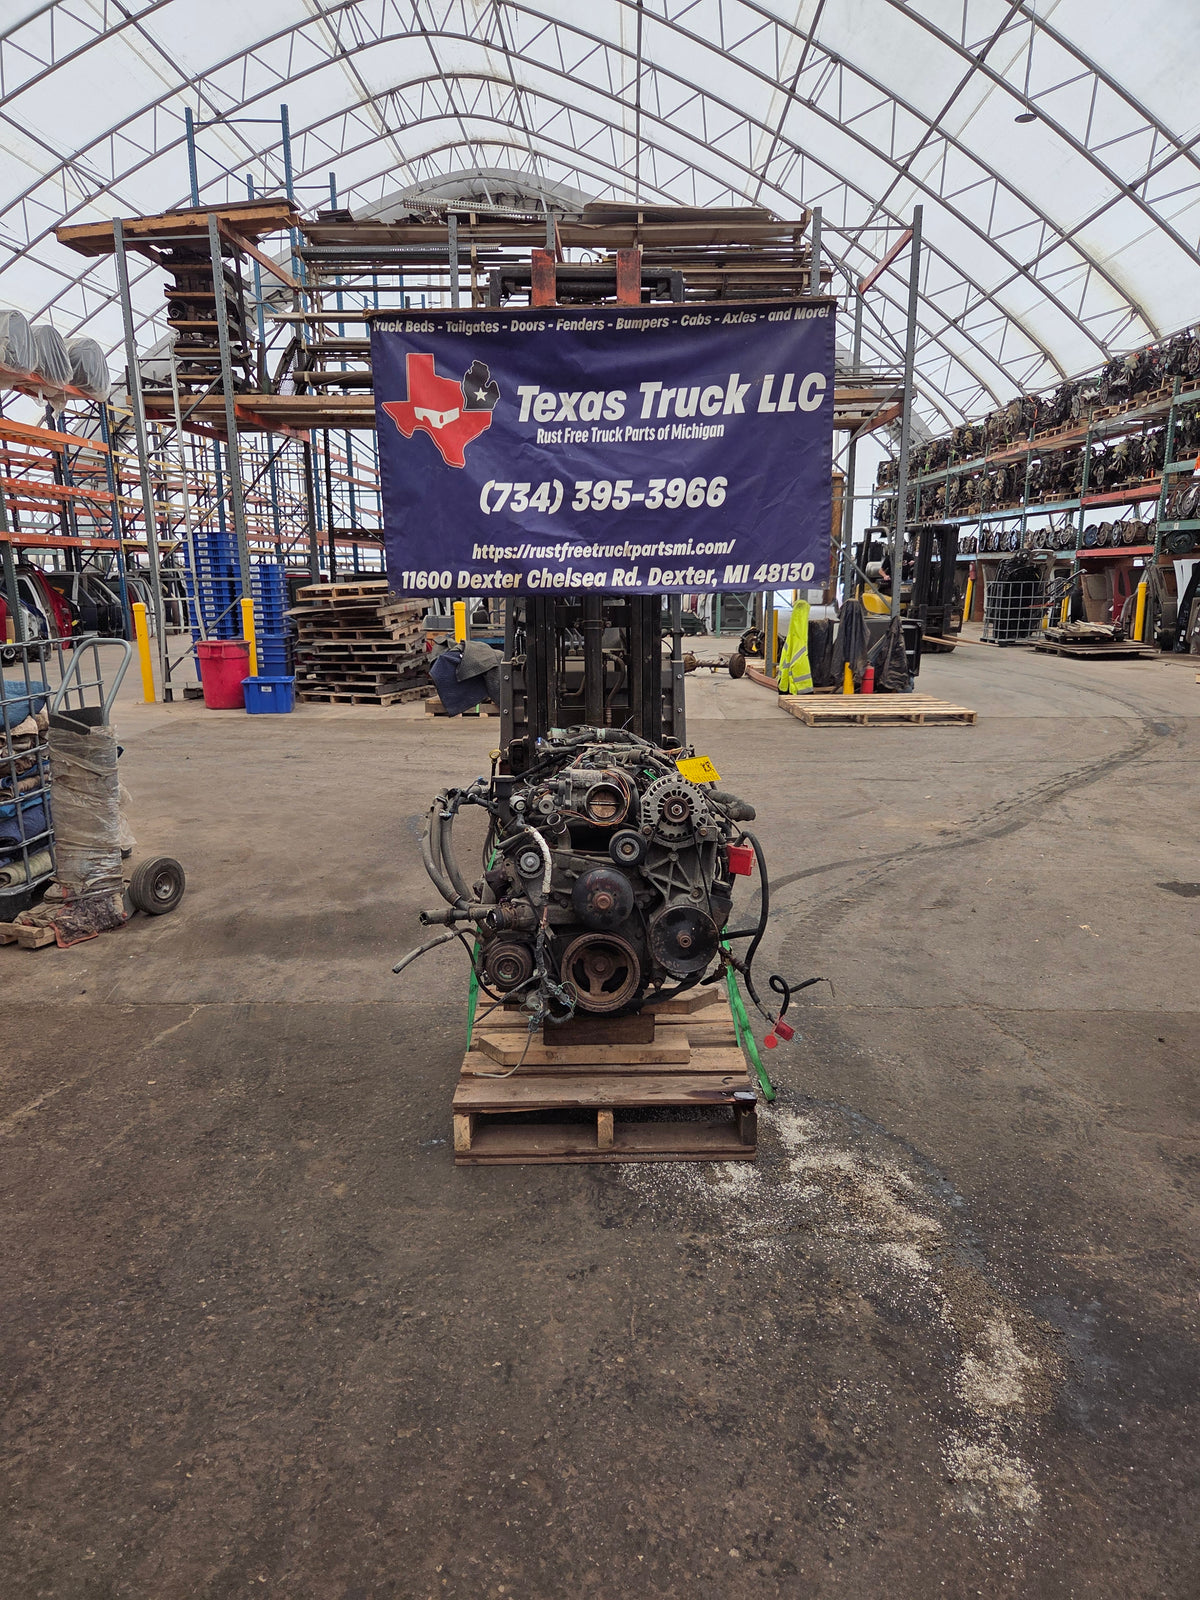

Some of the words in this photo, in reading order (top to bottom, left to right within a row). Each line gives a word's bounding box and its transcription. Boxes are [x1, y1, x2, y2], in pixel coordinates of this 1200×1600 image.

[405, 320, 435, 332] Beds
[446, 319, 500, 336] Tailgates
[510, 319, 546, 332] Doors
[556, 318, 605, 331] Fenders
[616, 316, 669, 332] Bumpers
[680, 314, 711, 327] Cabs
[722, 311, 757, 325] Axles
[768, 308, 792, 322] and
[793, 305, 830, 319] More!
[516, 385, 627, 422] Texas
[639, 373, 752, 420] Truck
[757, 372, 827, 413] LLC
[536, 427, 562, 444] Rust
[564, 427, 589, 443] Free
[591, 426, 623, 443] Truck
[624, 425, 656, 442] Parts
[657, 424, 671, 441] of
[671, 422, 725, 441] Michigan
[479, 479, 564, 515] (734)
[571, 476, 728, 512] 395-3966
[472, 538, 736, 563] https://rustfreetruckpartsmi.com/
[401, 570, 452, 590] 11600
[457, 570, 523, 589] Dexter
[527, 567, 607, 588] Chelsea
[611, 566, 642, 587] Rd.
[647, 566, 717, 587] Dexter,
[723, 565, 750, 584] MI
[753, 562, 815, 583] 48130
